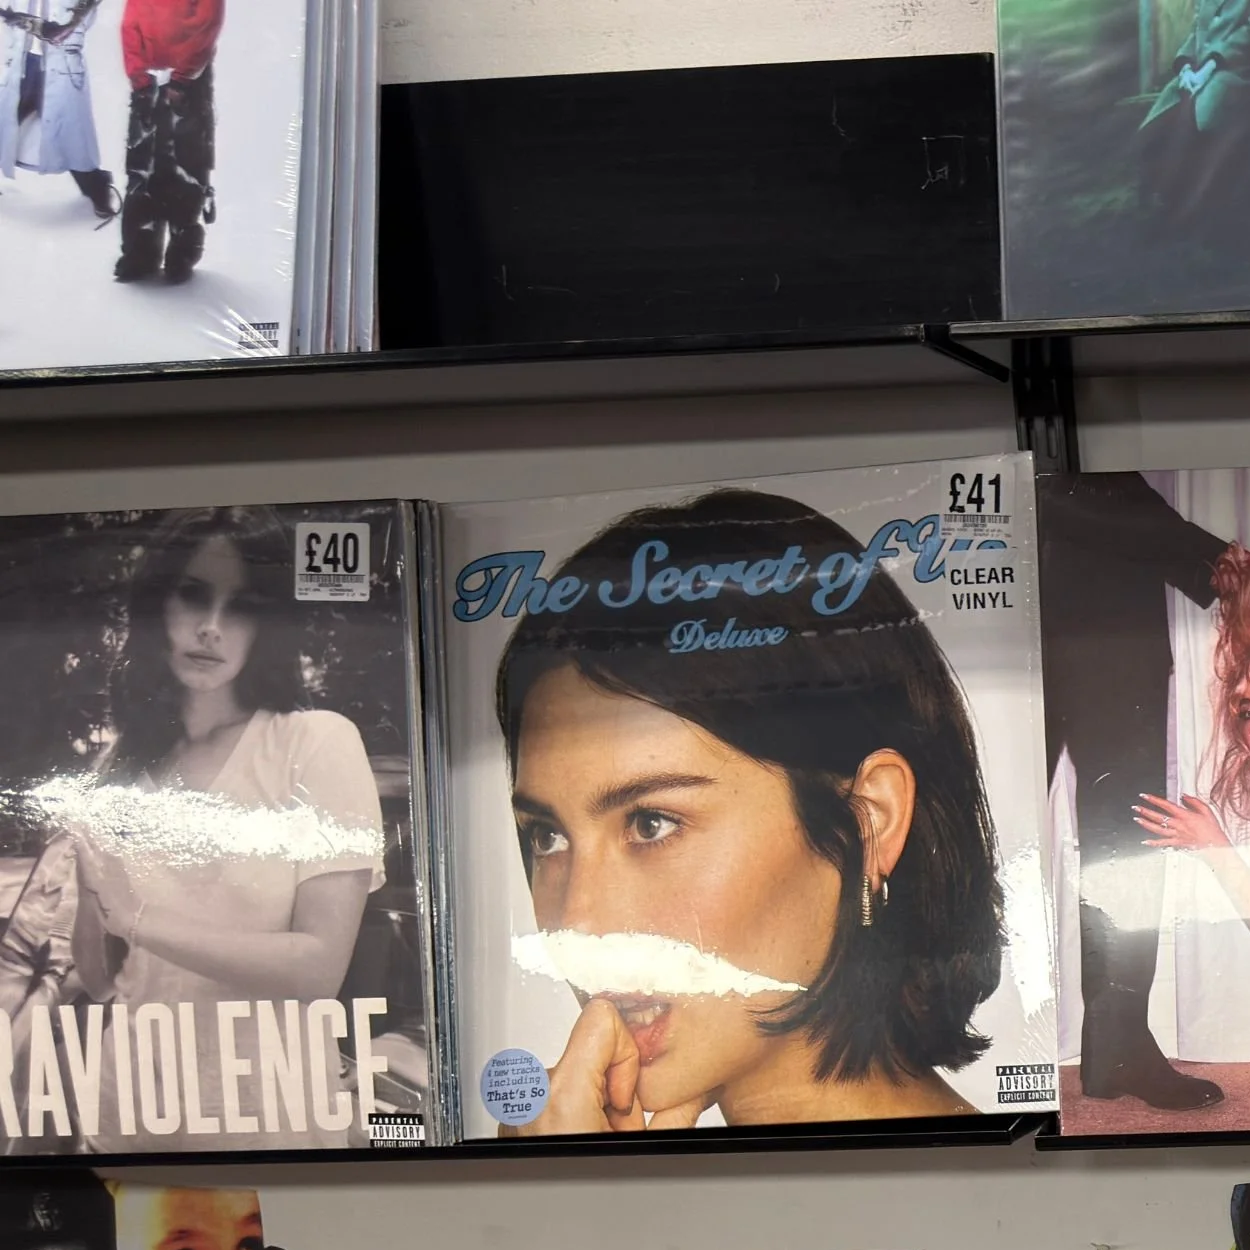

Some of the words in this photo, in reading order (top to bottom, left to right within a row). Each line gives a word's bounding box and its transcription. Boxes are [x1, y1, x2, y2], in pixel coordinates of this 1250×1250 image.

[949, 473, 1001, 514] £41
[305, 532, 359, 574] £40
[453, 549, 589, 622] The
[598, 540, 811, 609] Secret
[811, 519, 909, 616] of
[950, 566, 1015, 586] CLEAR
[952, 591, 1013, 610] VINYL
[669, 616, 790, 654] Deluxe
[491, 1055, 534, 1067] Featuring
[511, 1065, 540, 1075] tracks
[488, 1075, 541, 1088] including
[999, 1074, 1054, 1090] ADVISORY
[486, 1088, 526, 1102] That's
[530, 1087, 545, 1098] So
[502, 1102, 532, 1114] True
[372, 1117, 420, 1125] PARENTAL
[373, 1126, 420, 1139] ADVISORY
